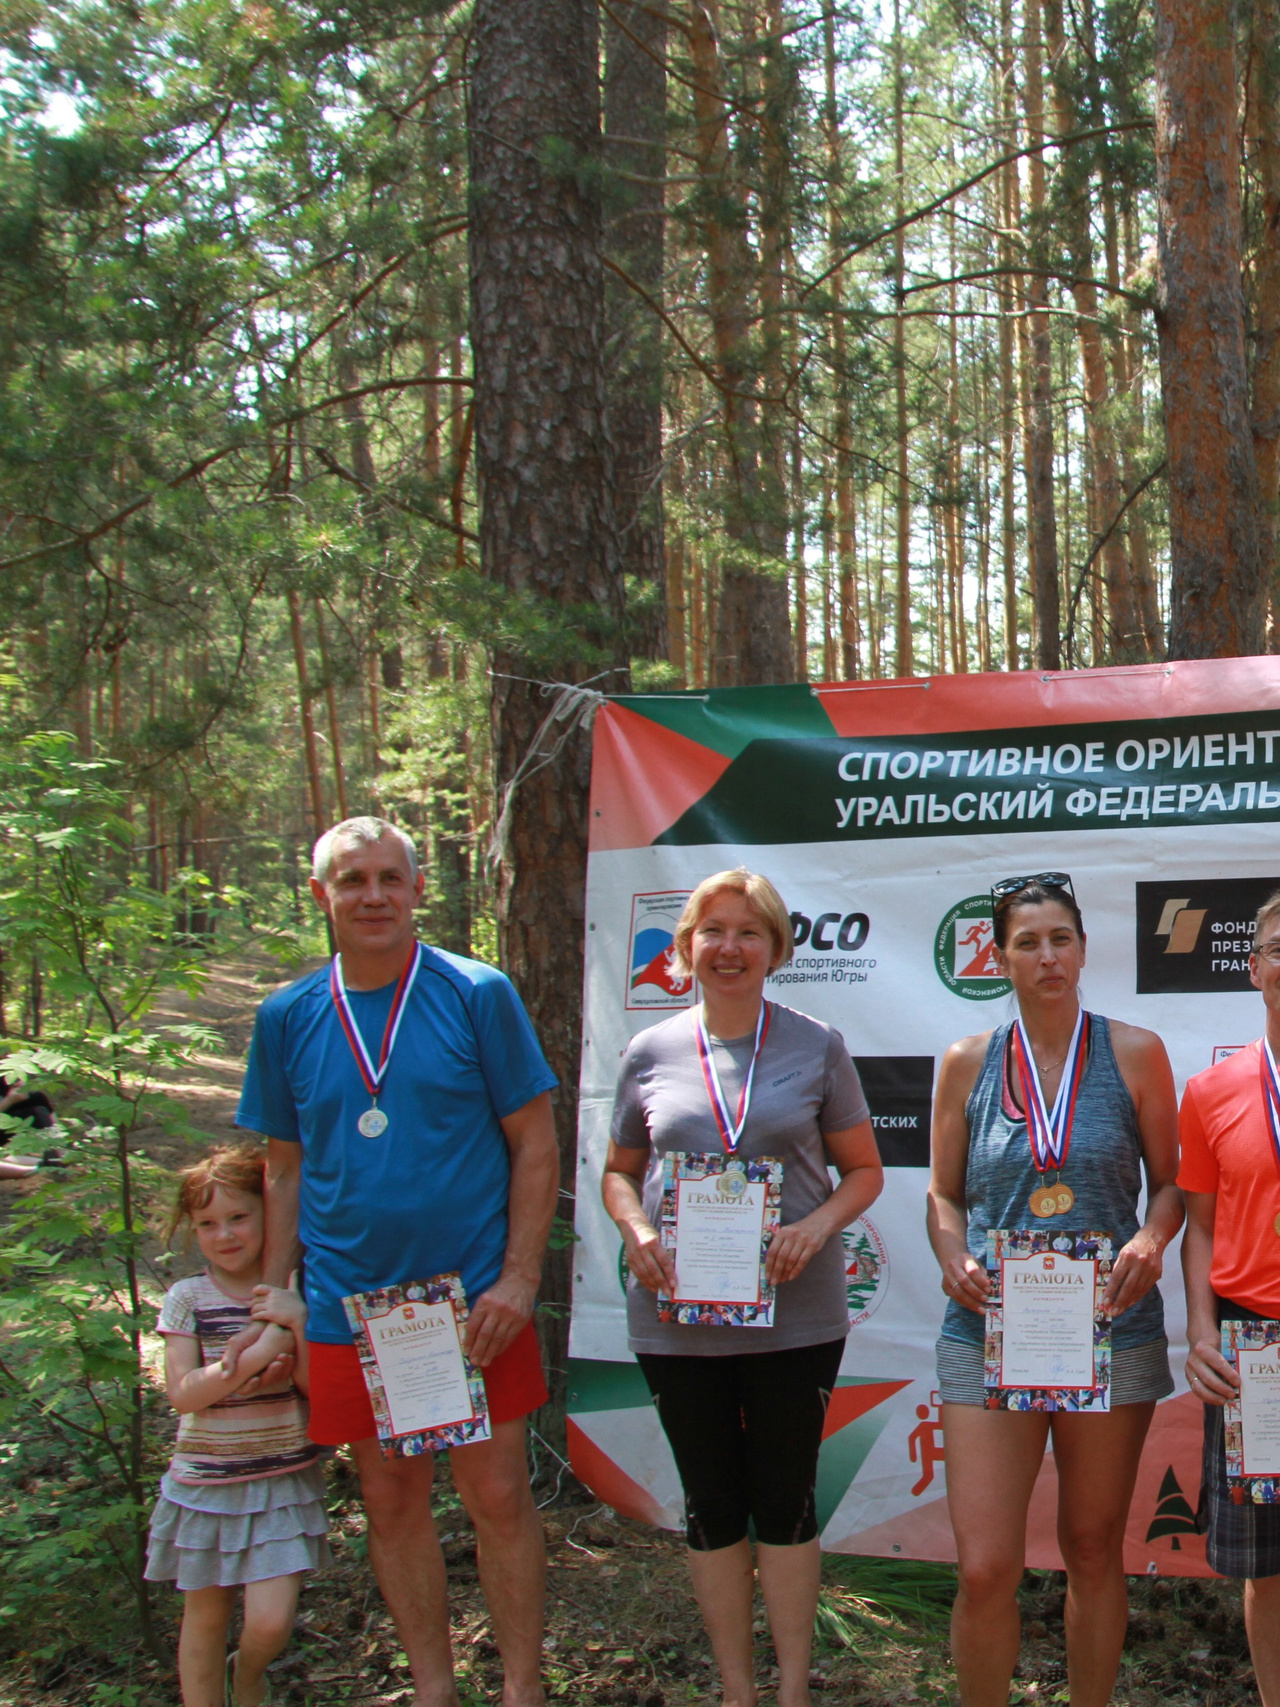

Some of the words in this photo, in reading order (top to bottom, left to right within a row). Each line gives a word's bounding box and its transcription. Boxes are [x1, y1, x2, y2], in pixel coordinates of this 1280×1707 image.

[838, 741, 1105, 782] СПОРТИВНОЕ
[835, 783, 1054, 828] УРАЛЬСКИЙ
[938, 910, 961, 951] ФЕДЕРАЦИЯ
[1211, 921, 1257, 936] ФОНД
[1211, 940, 1255, 953] ПРЕЗ
[795, 958, 877, 971] спортивного
[1211, 959, 1251, 972] ГРАН
[766, 972, 828, 987] тирования
[831, 969, 868, 985] Югры
[871, 1116, 918, 1128] ТСКИХ
[687, 1193, 755, 1206] ГРАМОТА
[1013, 1273, 1084, 1284] ГРАМОТА
[380, 1316, 446, 1339] ГРАМОТА
